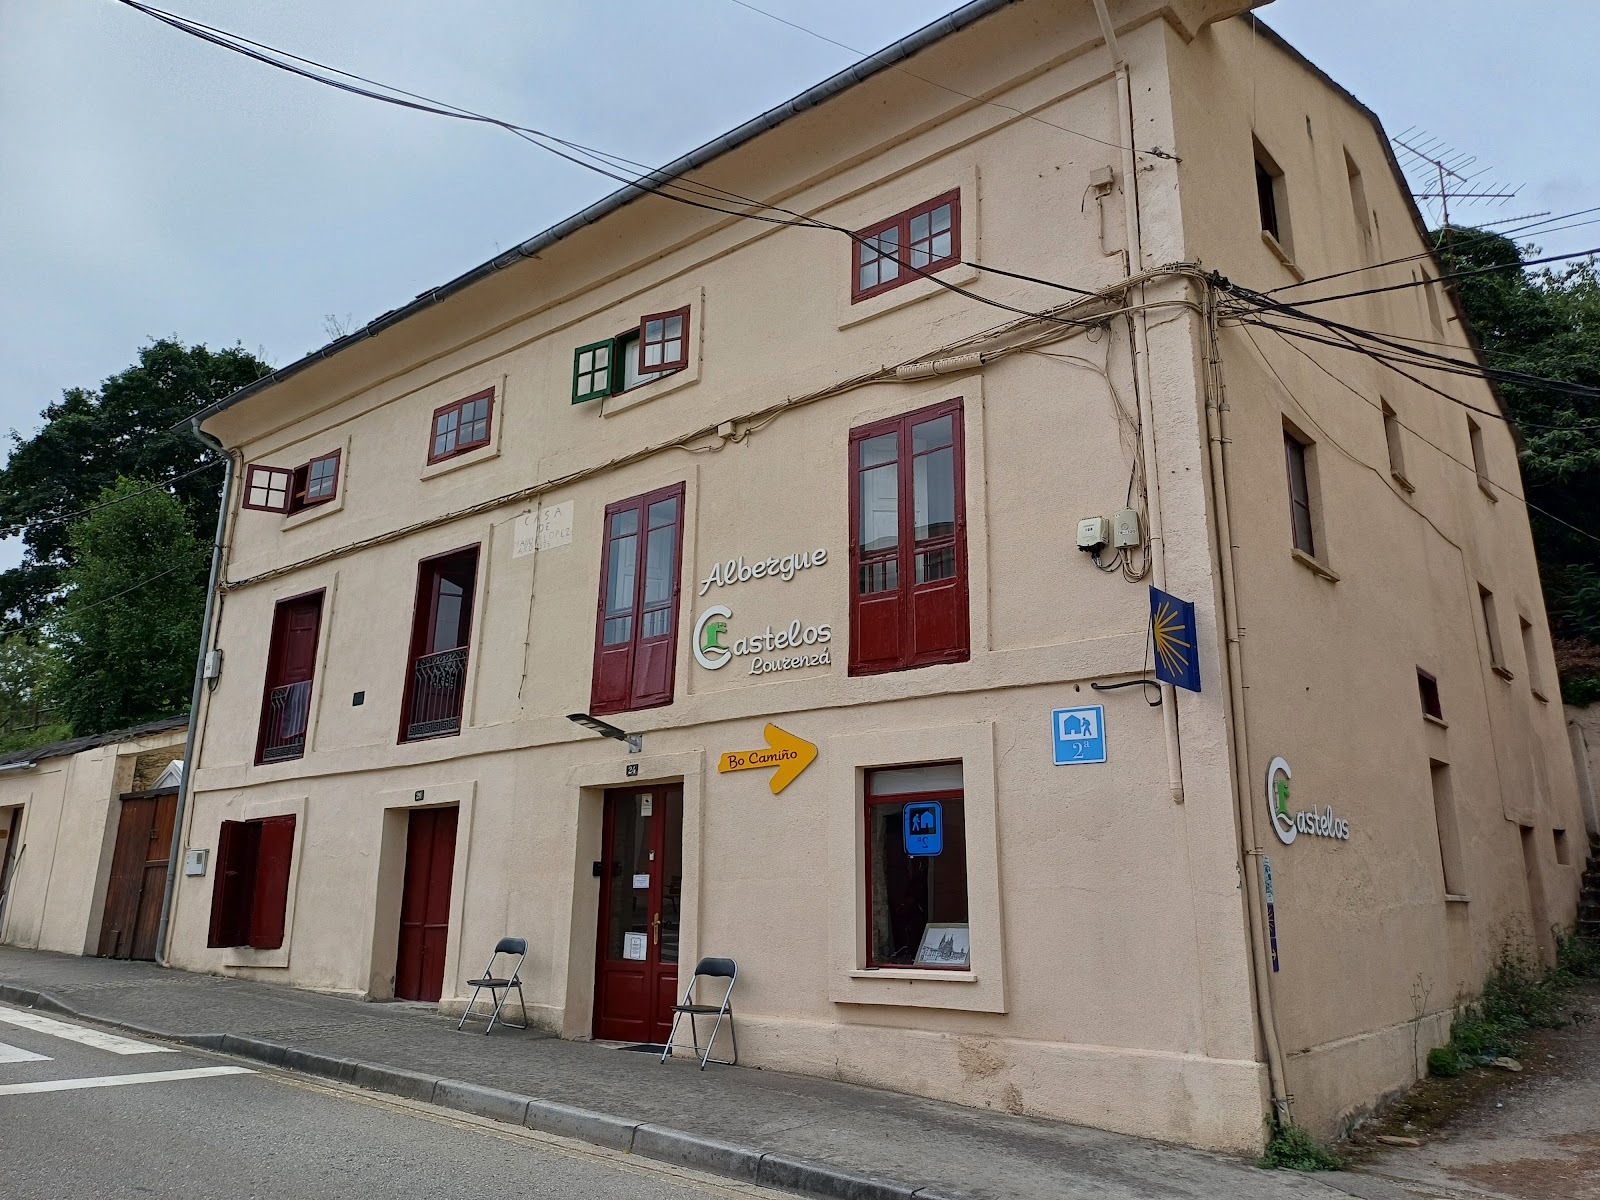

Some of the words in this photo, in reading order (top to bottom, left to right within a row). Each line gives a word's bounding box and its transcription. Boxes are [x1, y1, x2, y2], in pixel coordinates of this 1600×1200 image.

[699, 548, 828, 596] Albergue
[693, 604, 832, 670] Castelos
[748, 647, 832, 675] Lourenzá
[728, 755, 745, 769] Bo
[748, 749, 798, 764] Camiño
[1266, 755, 1350, 845] Castelos
